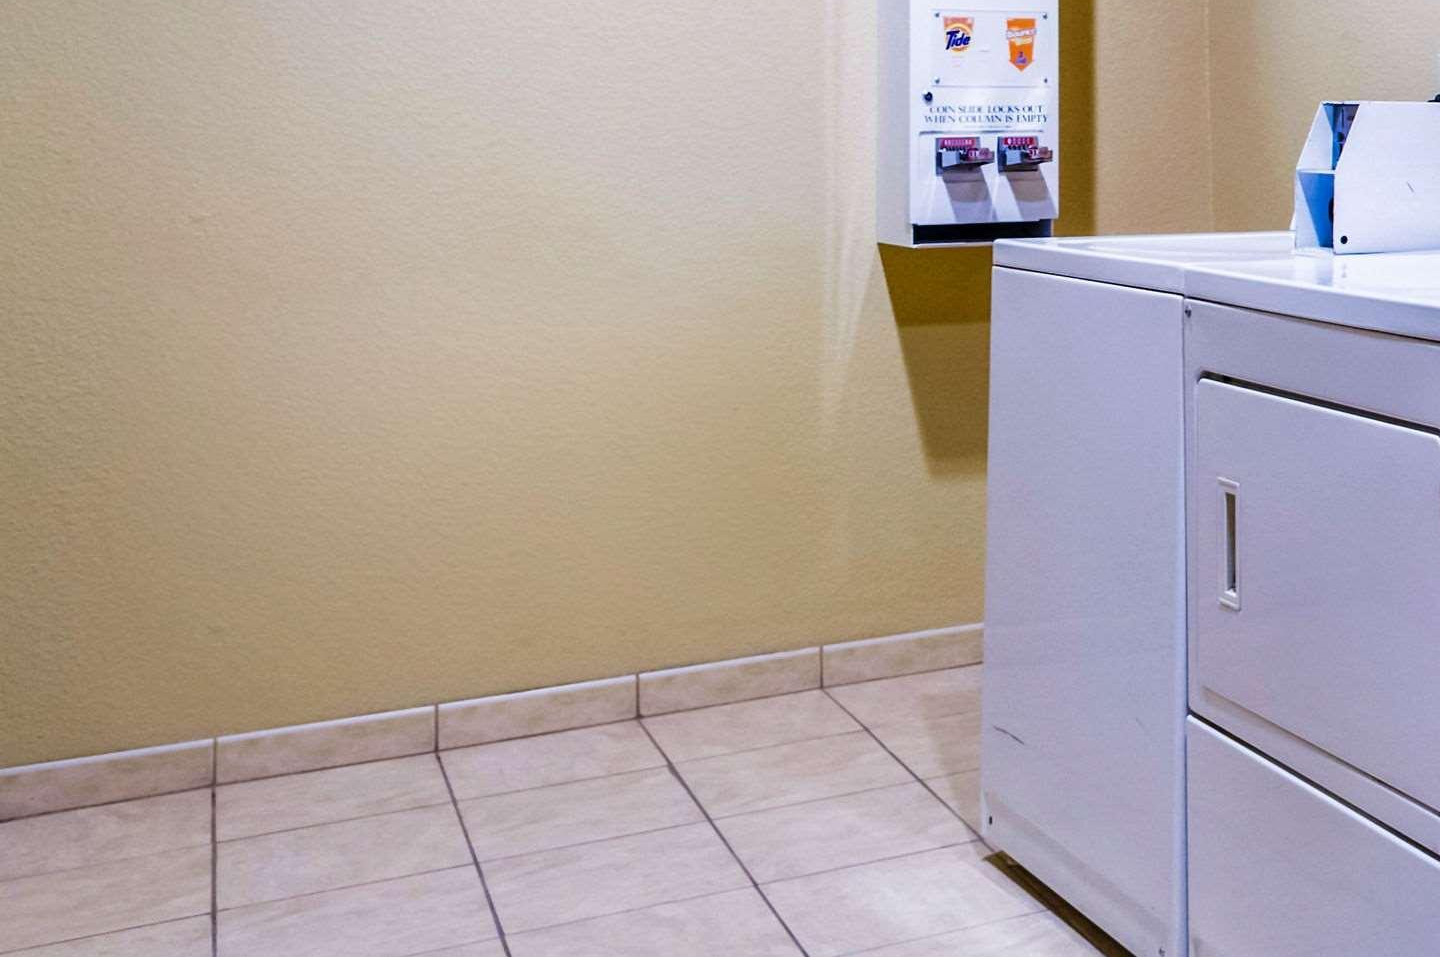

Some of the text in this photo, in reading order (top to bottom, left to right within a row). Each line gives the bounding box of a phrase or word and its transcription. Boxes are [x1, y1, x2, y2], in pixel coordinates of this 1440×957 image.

[945, 30, 971, 50] Tide
[929, 105, 955, 113] COIN
[987, 105, 1020, 113] LOCKS
[1022, 105, 1043, 113] OUT
[925, 115, 955, 123] WHEN
[1016, 114, 1048, 123] EMPTY
